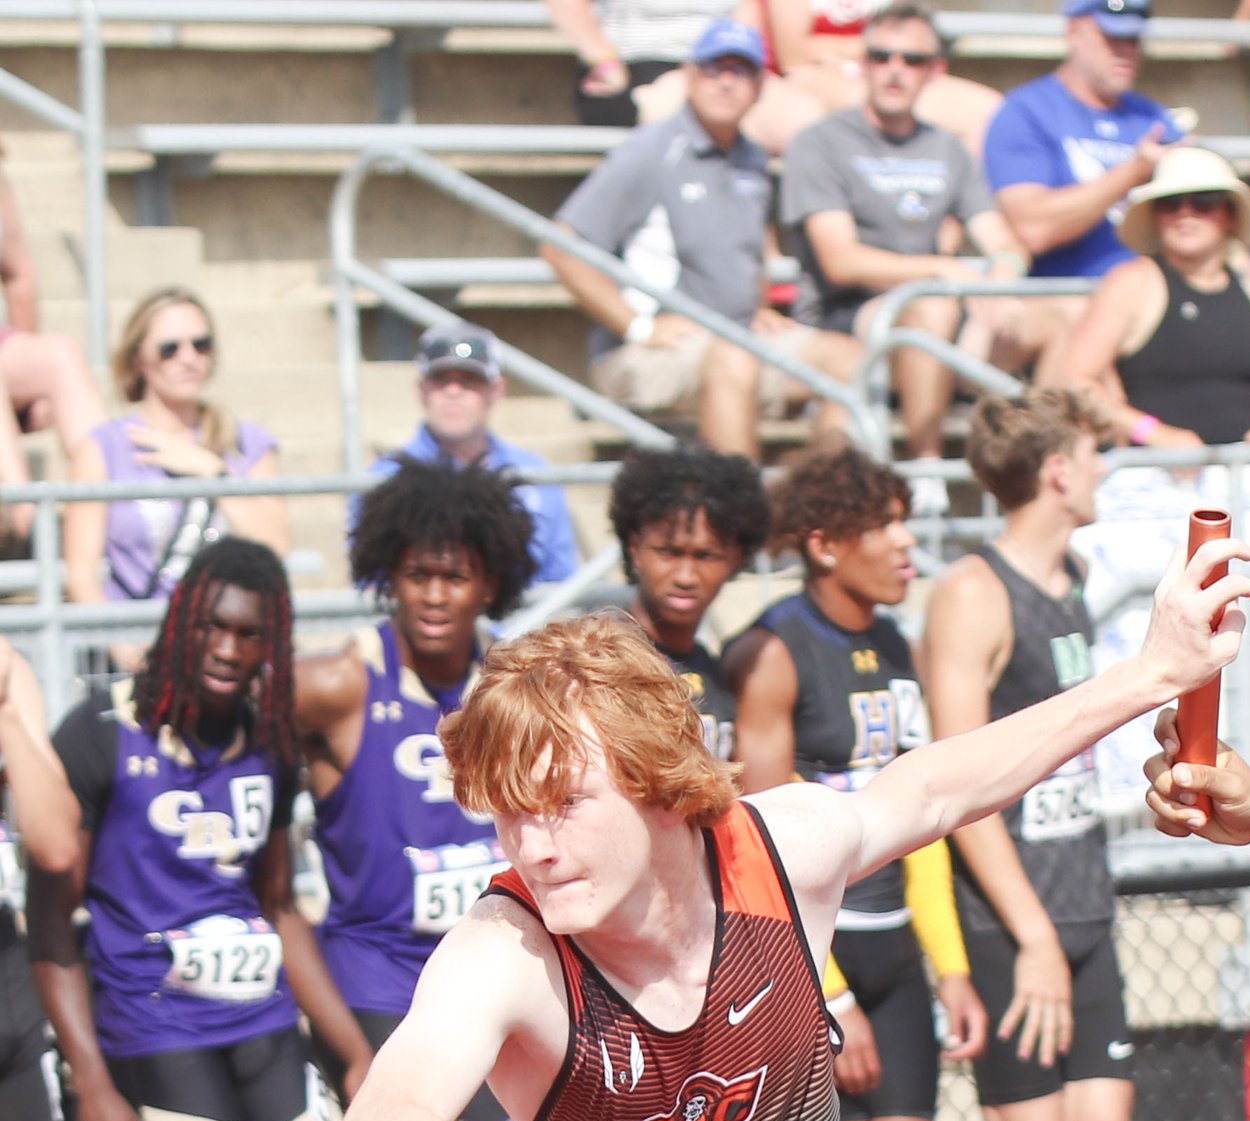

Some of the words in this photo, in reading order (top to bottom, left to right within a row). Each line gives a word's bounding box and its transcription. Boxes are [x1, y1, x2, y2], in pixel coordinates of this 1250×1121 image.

[848, 690, 897, 768] H
[244, 785, 265, 838] 5
[181, 944, 272, 984] 5122
